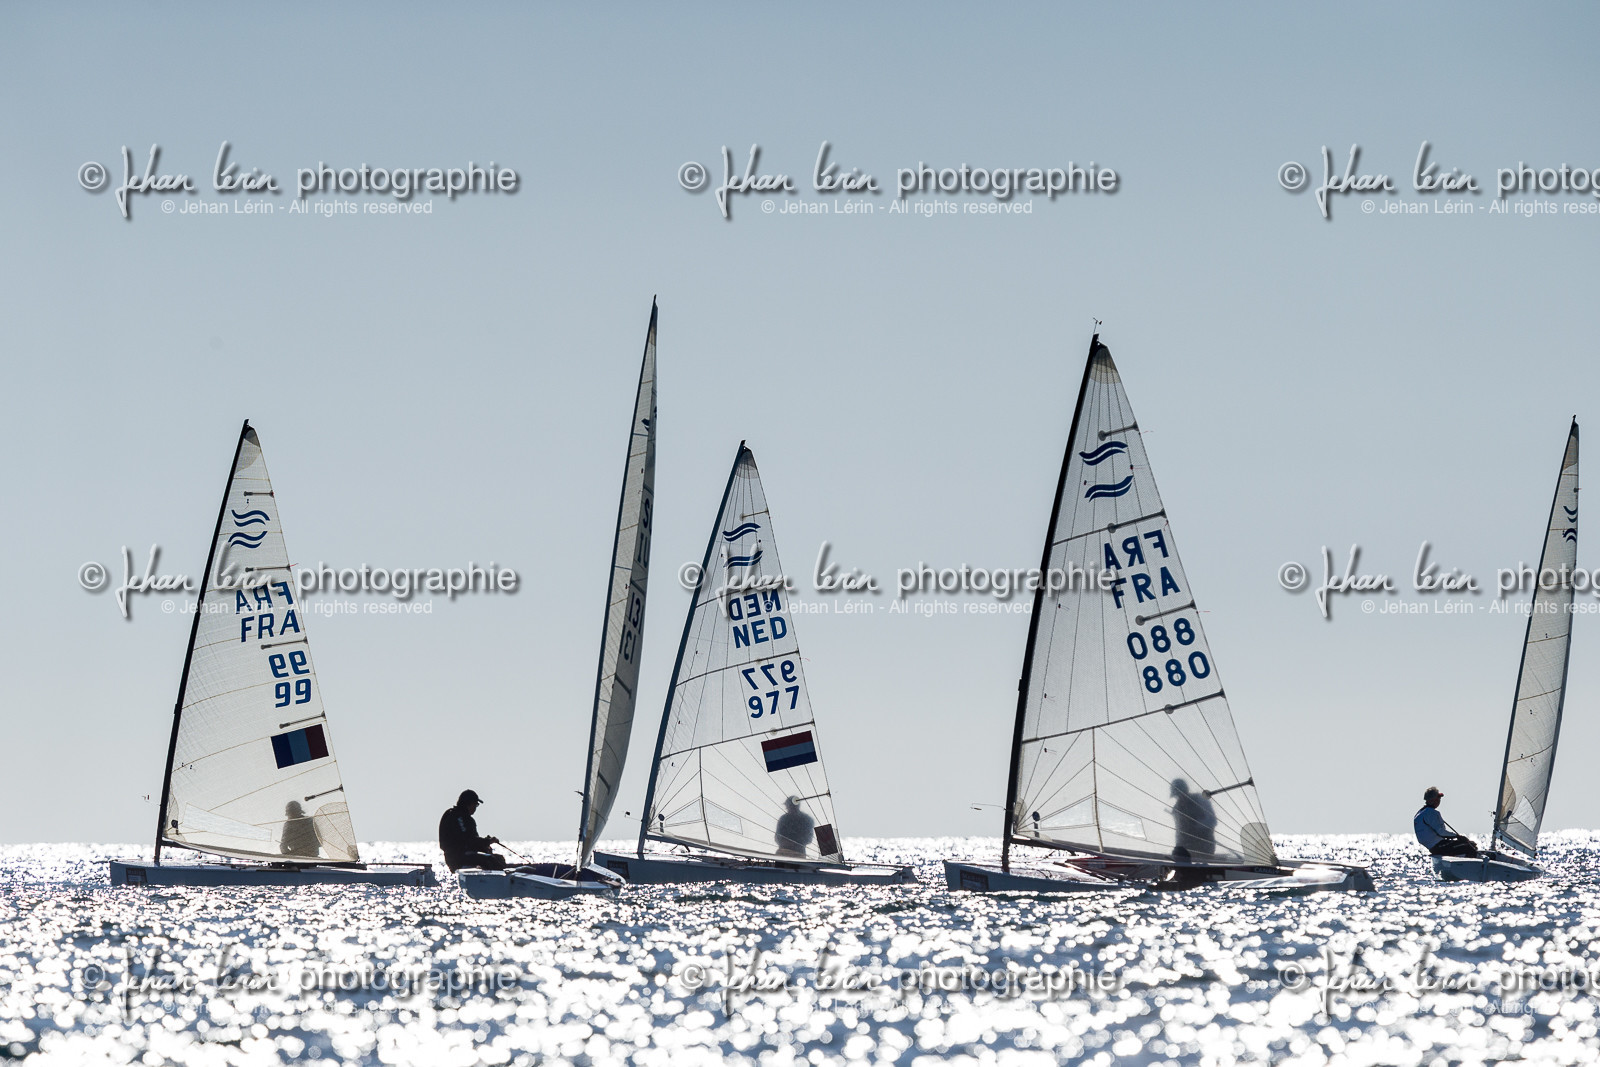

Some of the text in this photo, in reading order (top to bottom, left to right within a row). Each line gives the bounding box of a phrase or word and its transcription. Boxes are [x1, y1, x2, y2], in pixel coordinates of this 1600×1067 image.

[1109, 566, 1181, 609] FRA
[241, 610, 300, 642] FRA
[732, 616, 787, 649] NED
[1142, 651, 1210, 694] 880
[275, 678, 311, 708] 99
[748, 685, 799, 718] 977
